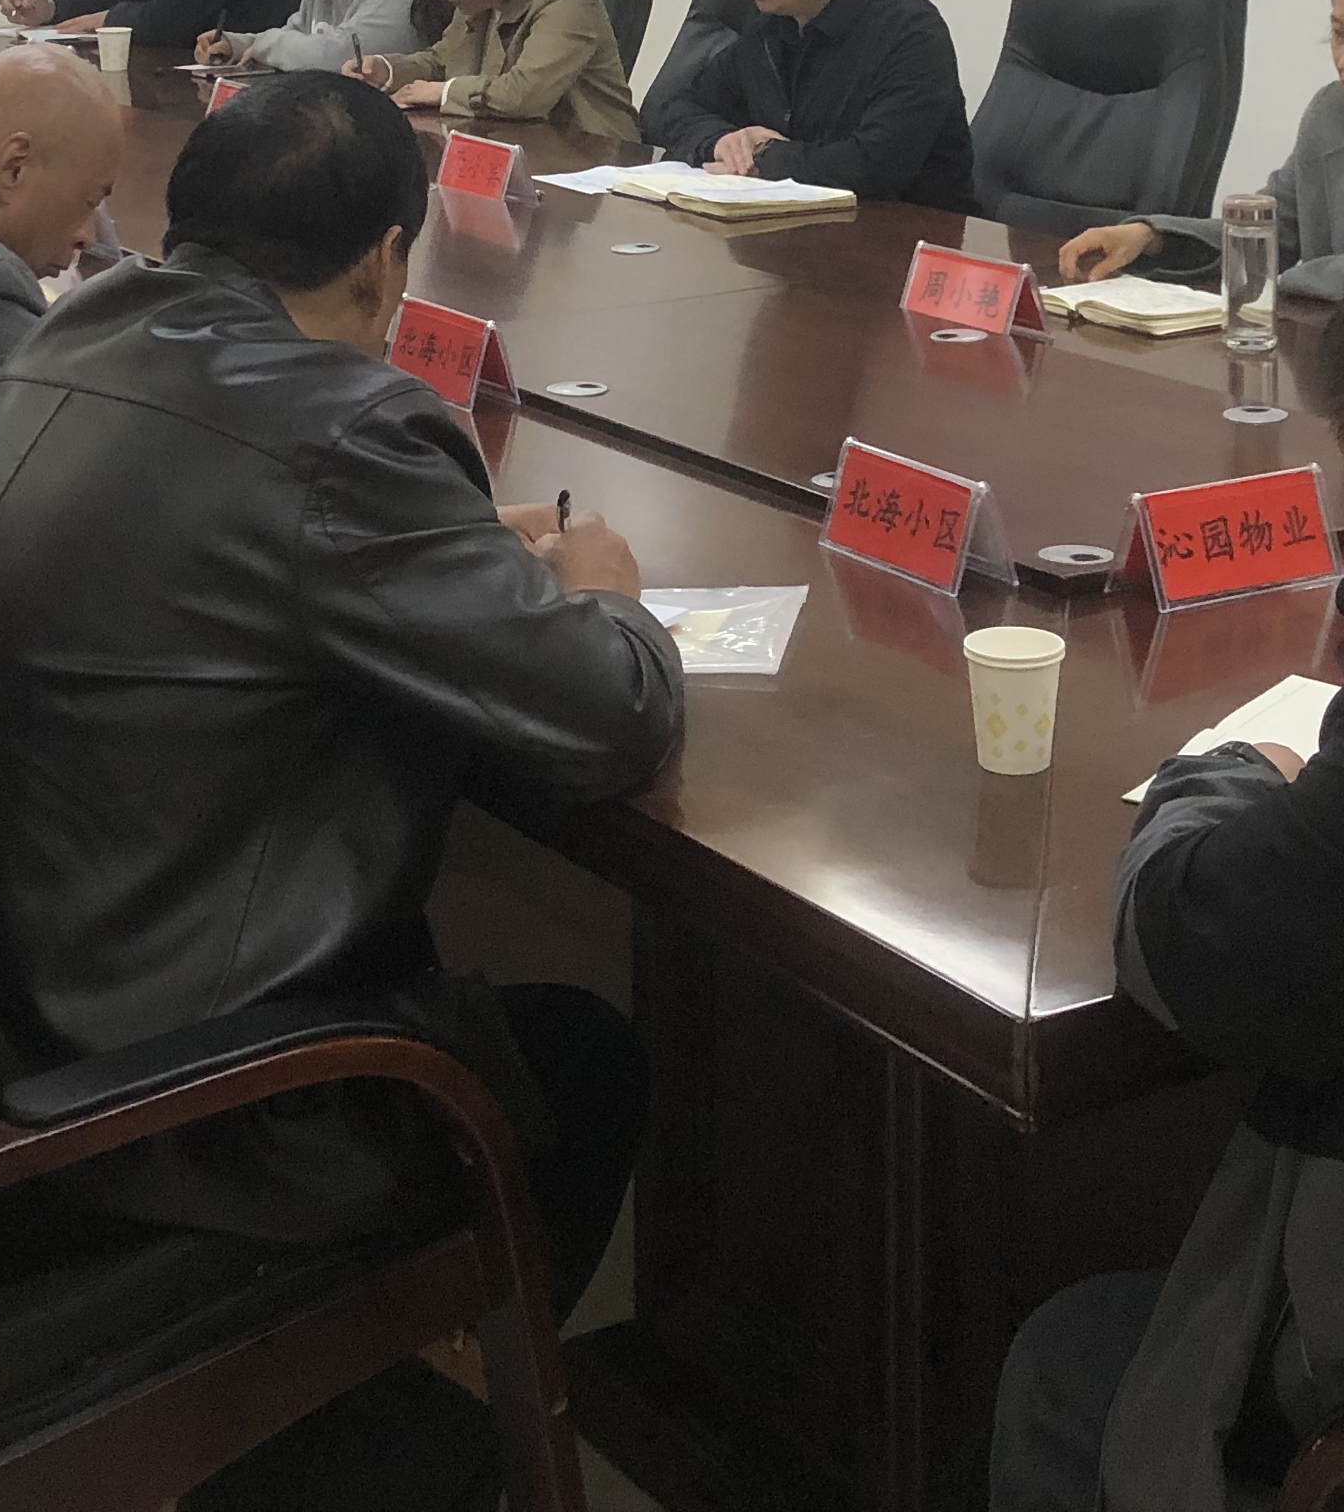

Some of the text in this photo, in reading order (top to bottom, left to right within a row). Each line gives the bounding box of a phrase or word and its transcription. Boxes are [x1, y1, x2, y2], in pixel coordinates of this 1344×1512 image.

[843, 476, 962, 554] 北海小区
[1156, 504, 1317, 569] 沁园物业
